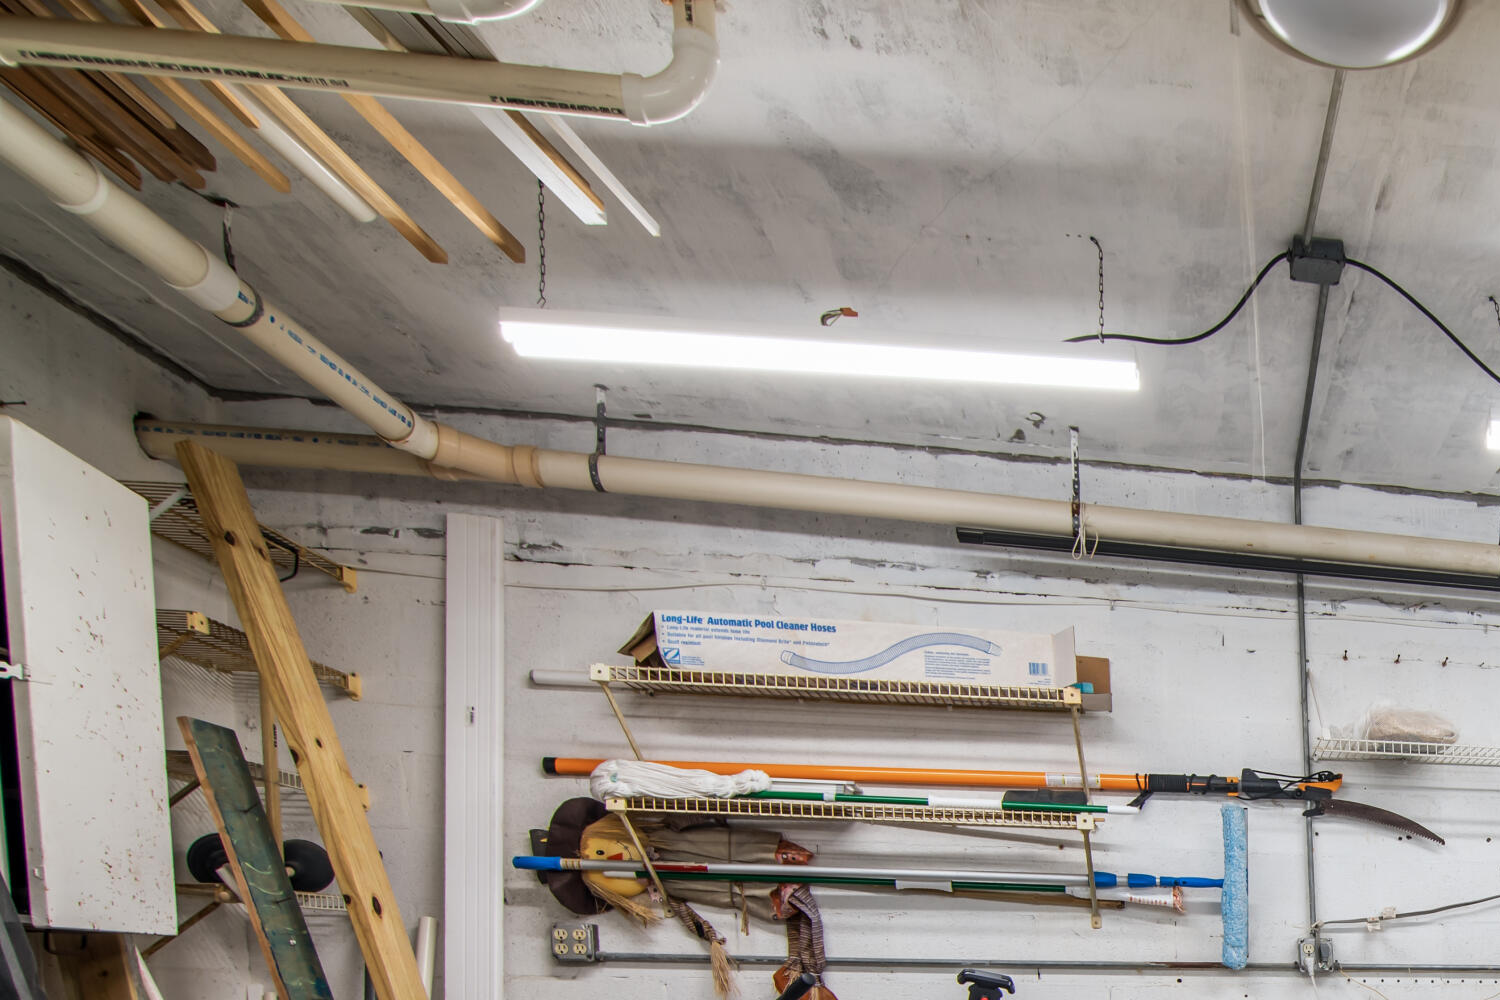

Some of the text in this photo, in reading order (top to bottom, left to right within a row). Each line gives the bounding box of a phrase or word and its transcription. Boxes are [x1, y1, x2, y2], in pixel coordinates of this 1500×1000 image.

[661, 614, 837, 633] Long-Life Automatic Pool Cleaner Hoses
